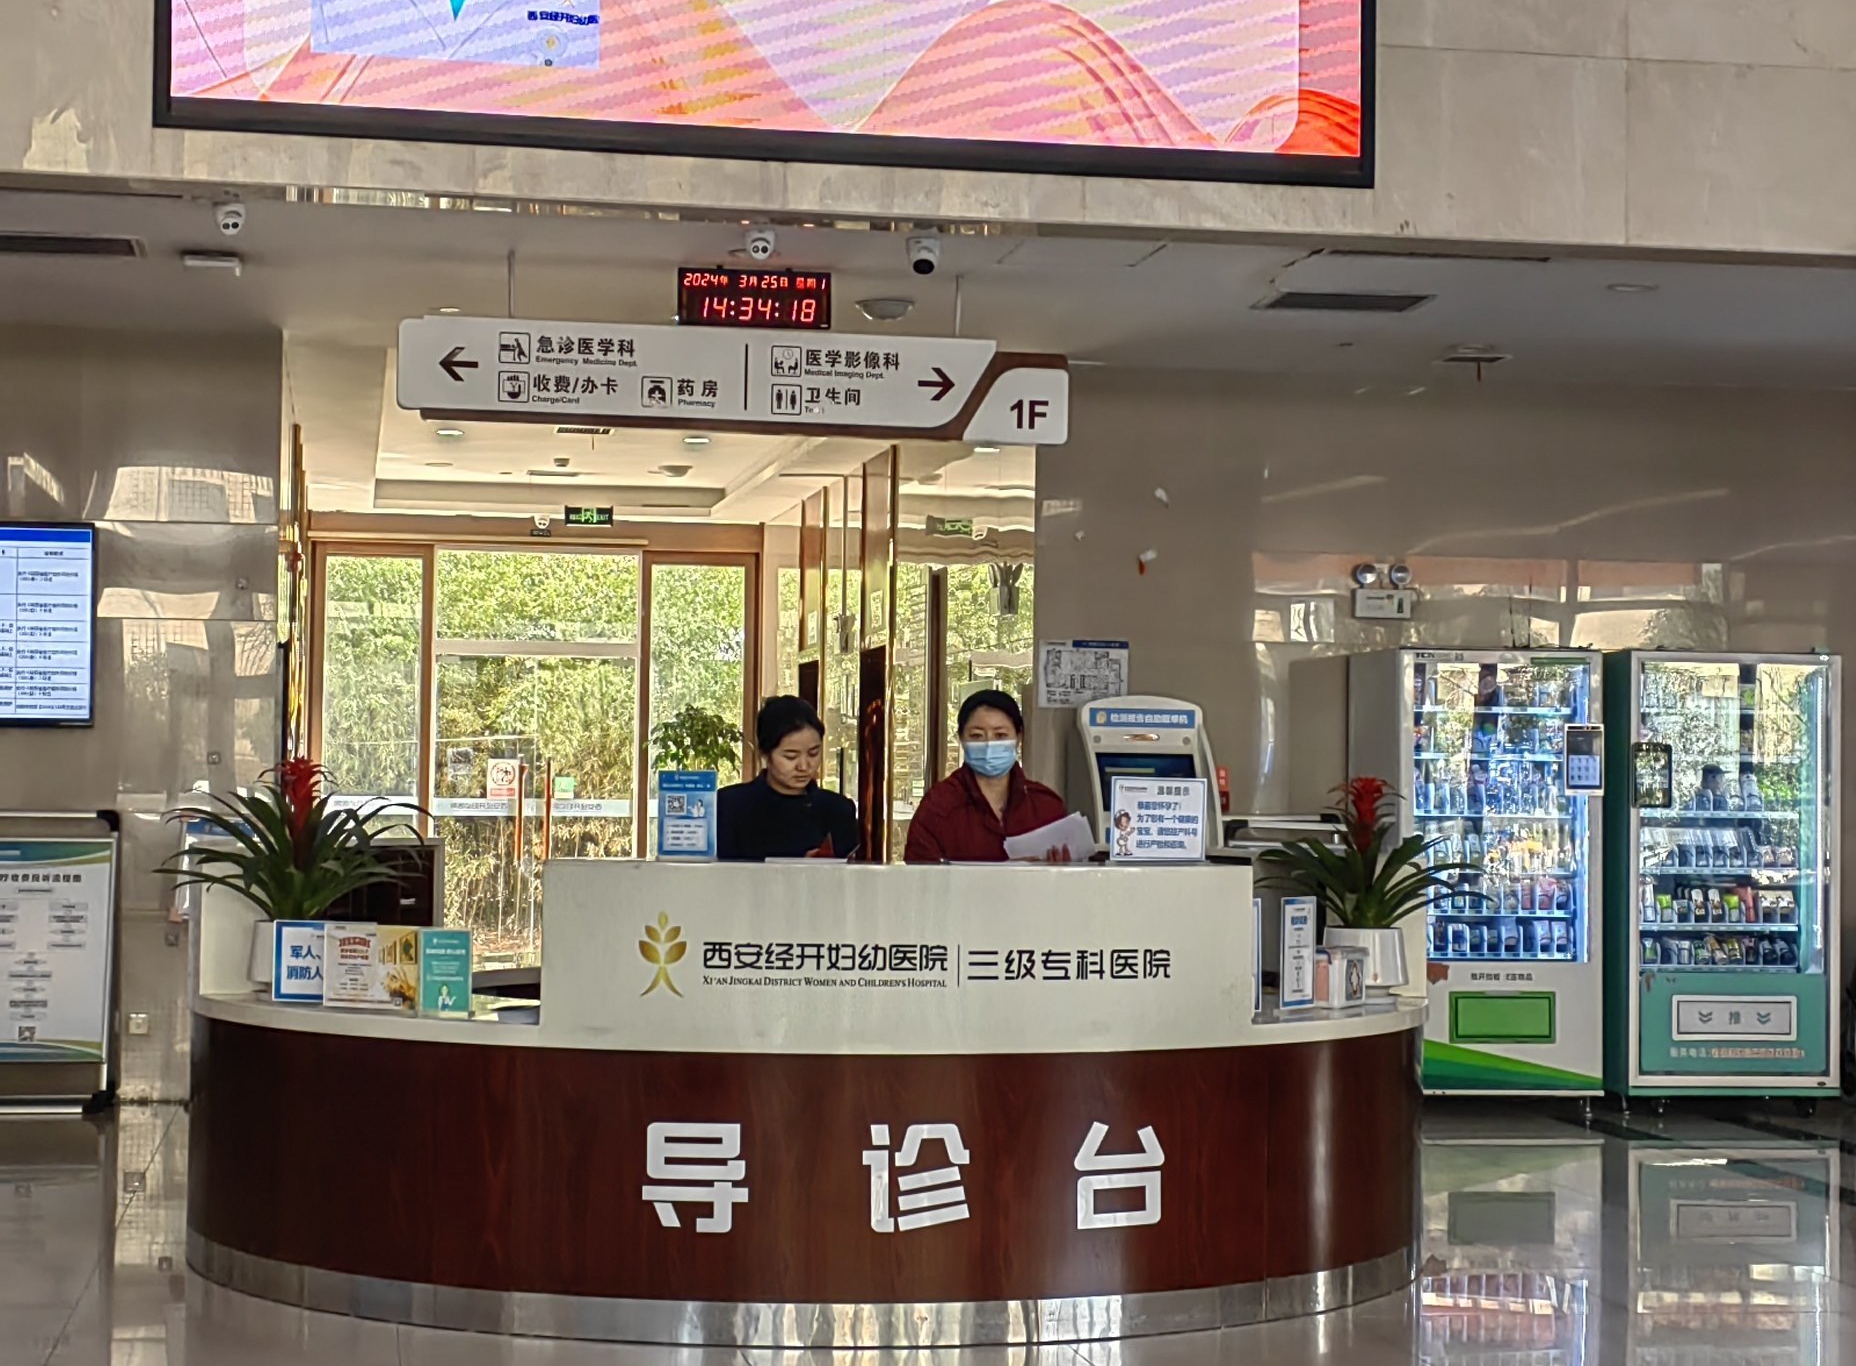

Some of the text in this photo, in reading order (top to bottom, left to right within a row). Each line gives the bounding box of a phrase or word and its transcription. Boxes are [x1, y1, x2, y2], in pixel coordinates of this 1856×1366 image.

[703, 297, 816, 322] 14:34:18
[536, 335, 636, 358] 急诊医学科
[535, 356, 579, 366] Emergency
[805, 349, 900, 370] 医学影像科
[805, 369, 832, 377] Medical
[834, 370, 864, 379] Imaging
[532, 374, 618, 395] 收费/办卡
[677, 378, 718, 398] 药房
[678, 398, 716, 408] Pharmacy
[805, 387, 860, 405] 卫生间
[1010, 399, 1049, 430] 1F
[703, 942, 1172, 981] 西安经开妇幼医院 三级专科医院
[287, 966, 323, 980] 消防人
[728, 976, 762, 986] JINGKAI
[763, 977, 802, 986] DISTRICT
[804, 977, 837, 987] WOMEN
[839, 978, 856, 987] AND
[907, 978, 947, 988] HOSPITAL
[641, 1121, 1166, 1234] 导诊台
